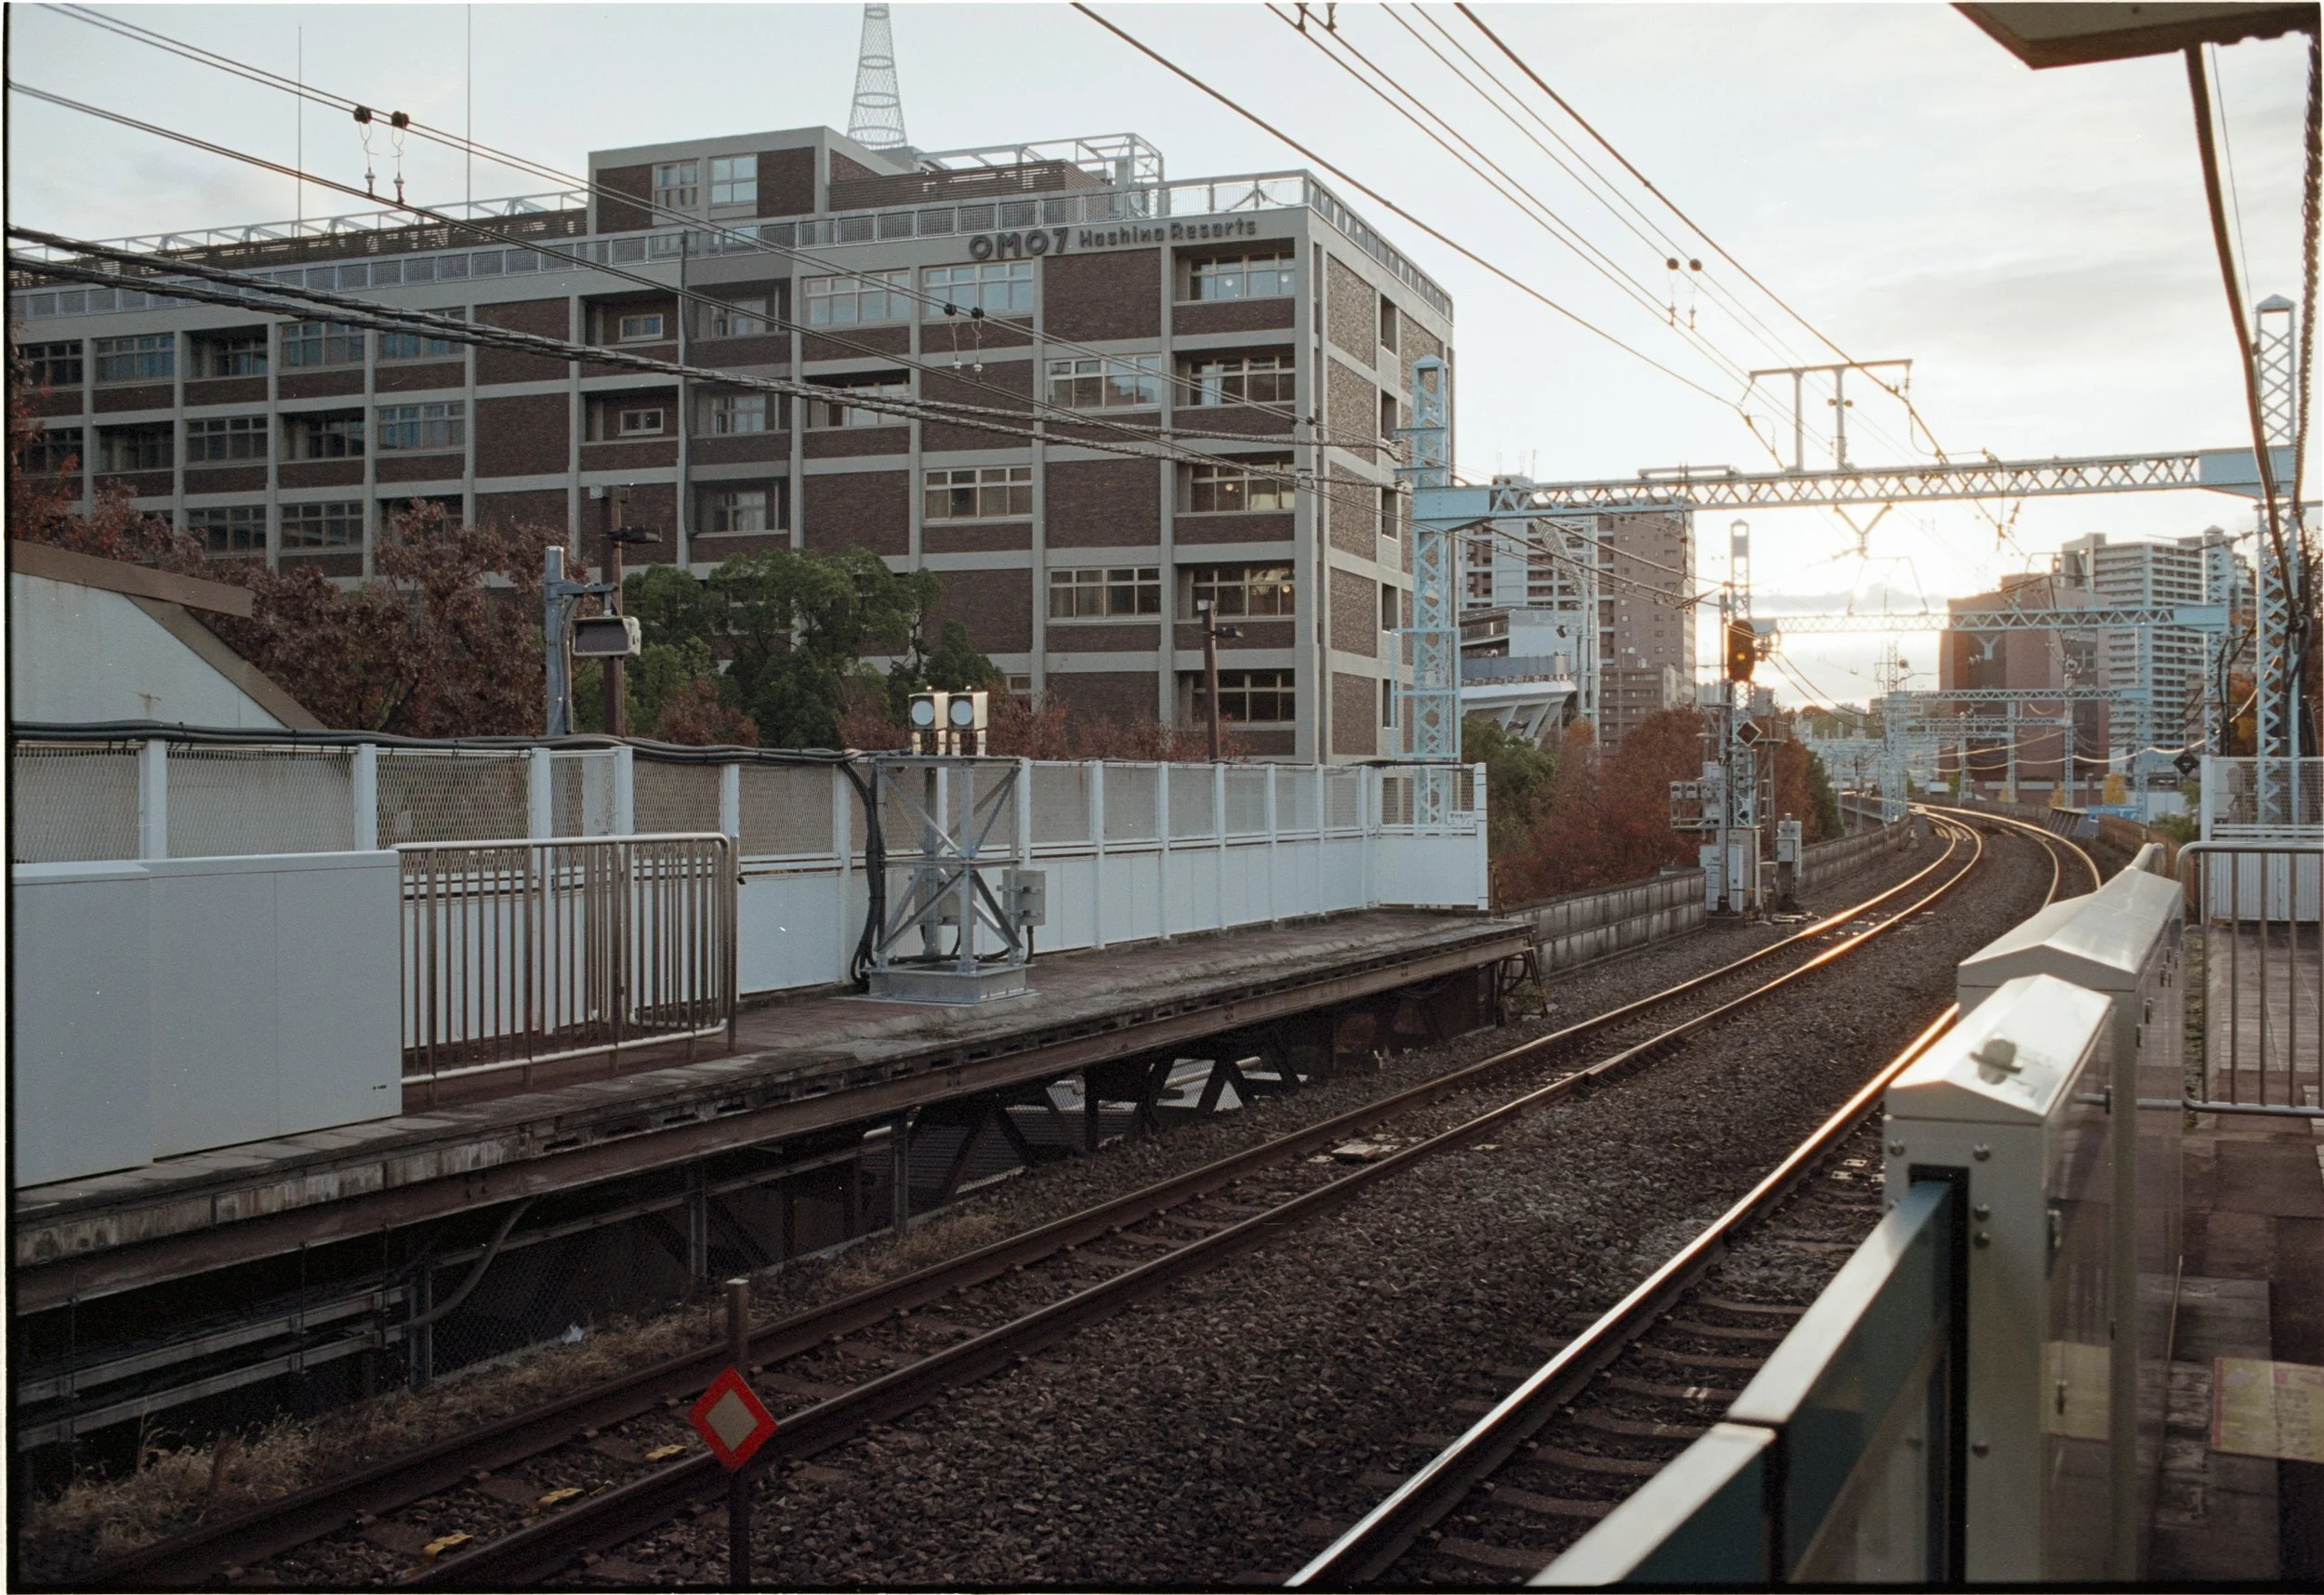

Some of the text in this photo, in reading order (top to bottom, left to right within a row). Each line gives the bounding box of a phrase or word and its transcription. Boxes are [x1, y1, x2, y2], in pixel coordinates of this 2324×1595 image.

[969, 217, 1256, 259] OMO7 Hoshino Resorts
